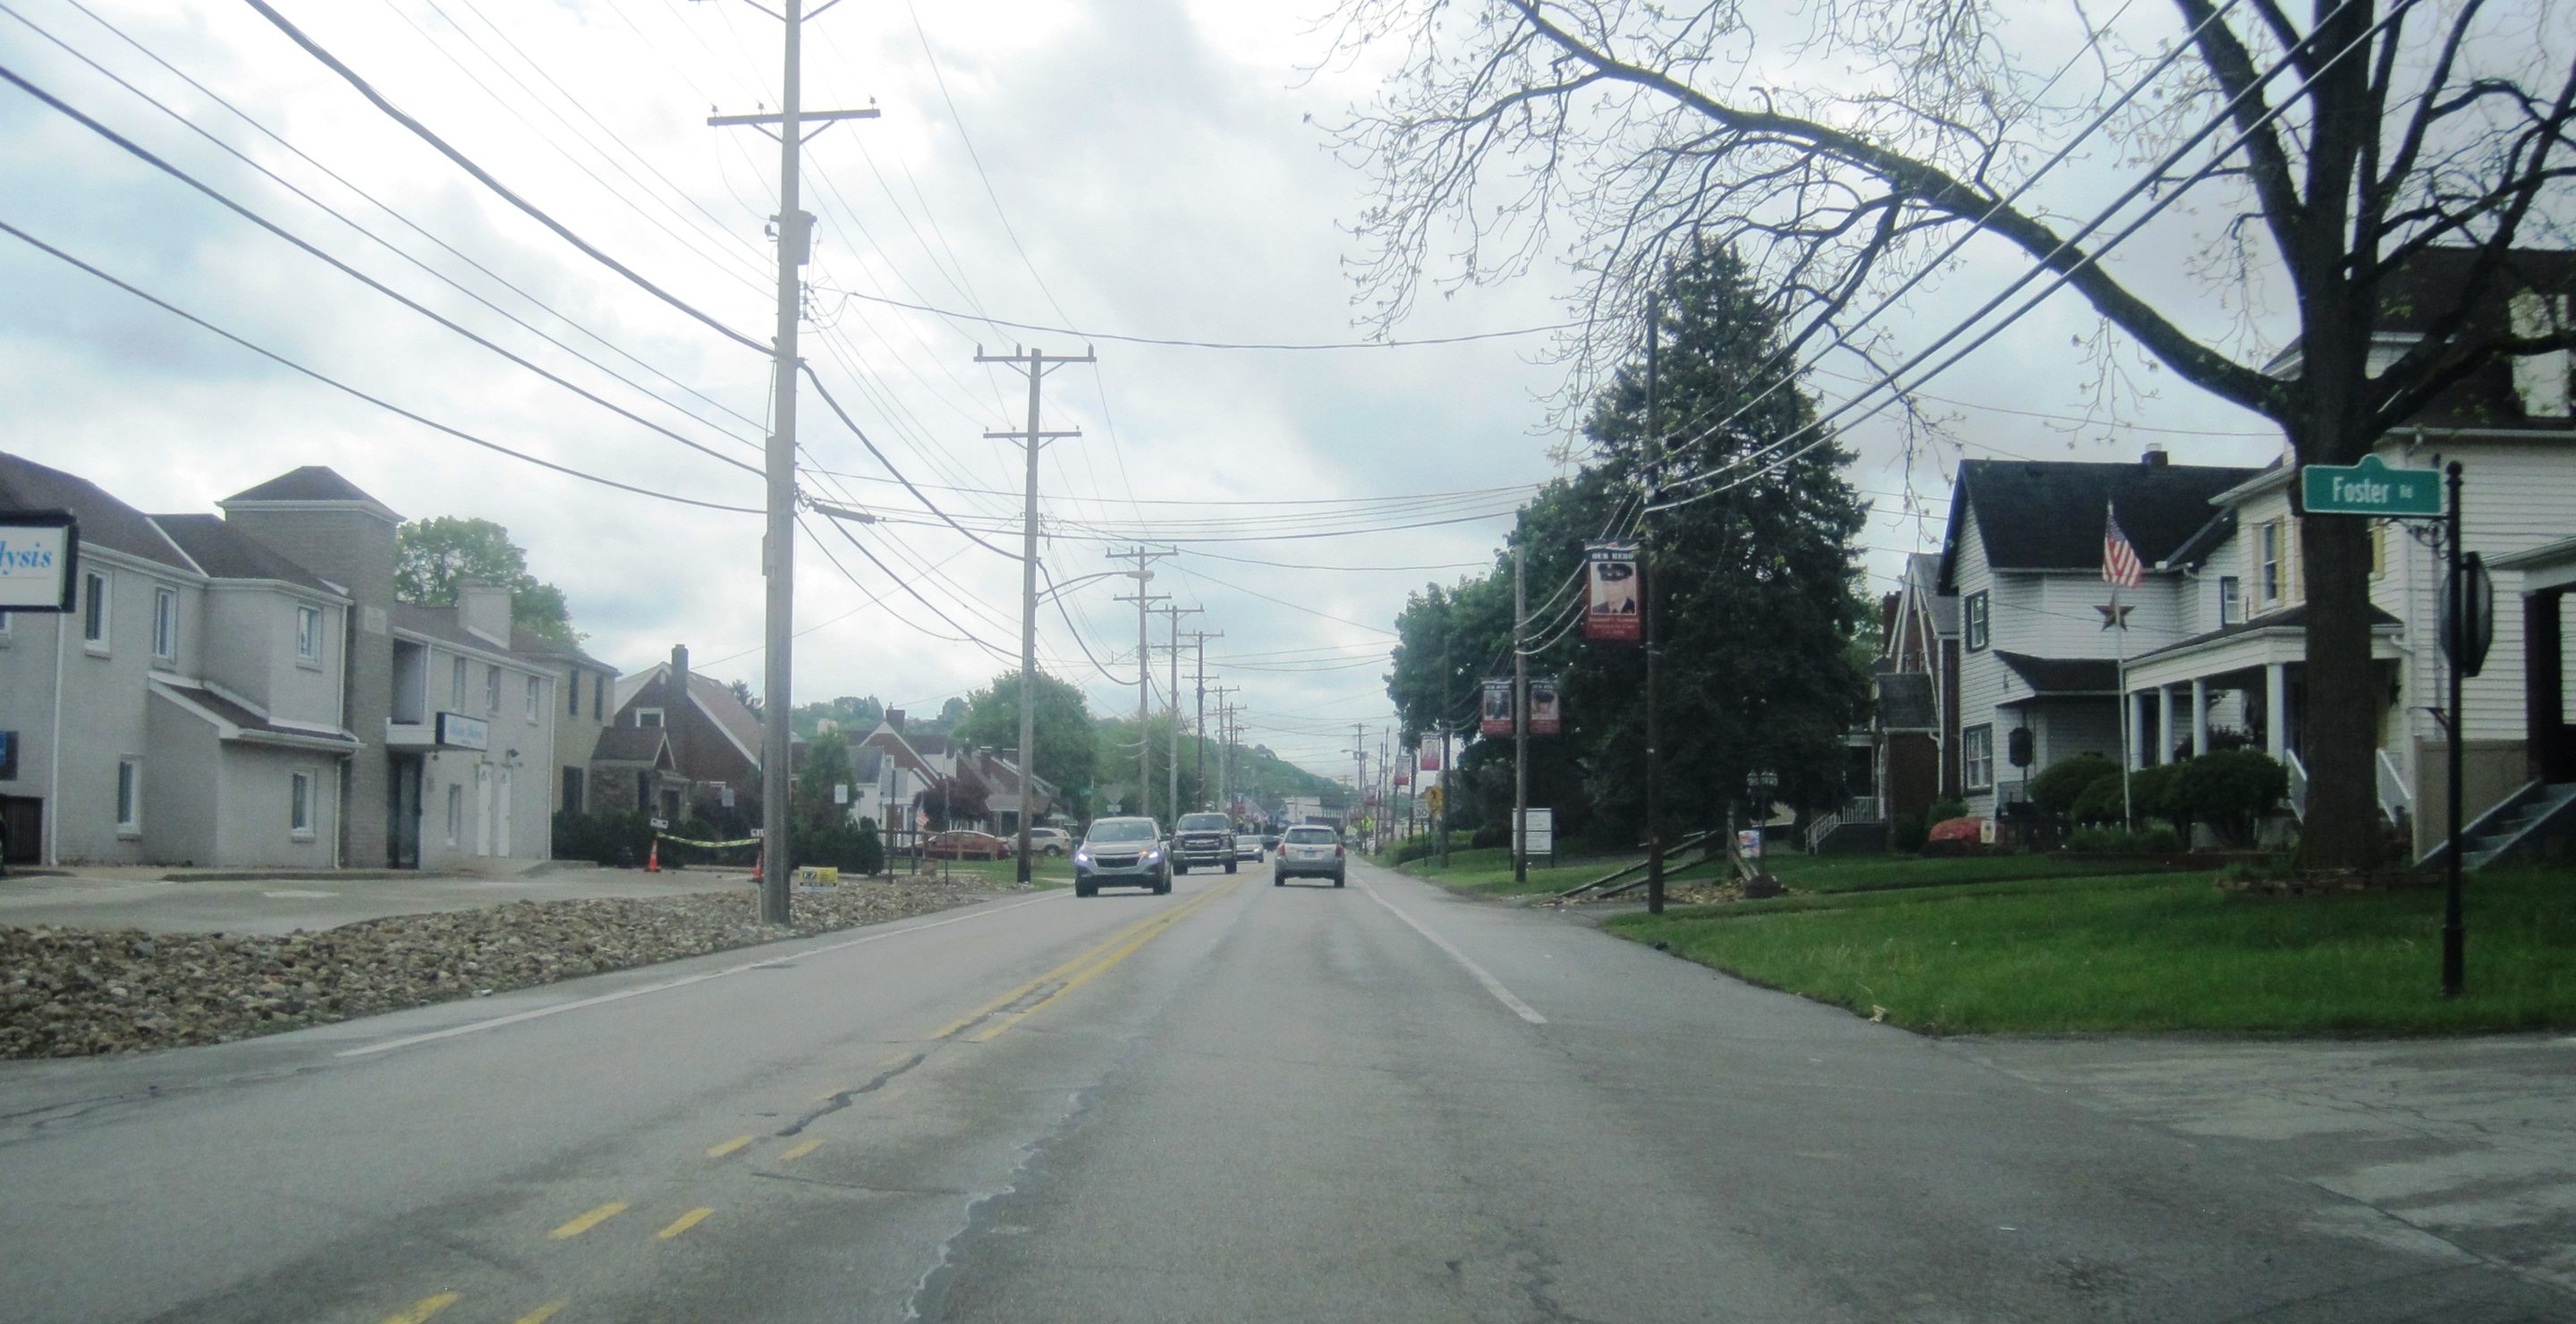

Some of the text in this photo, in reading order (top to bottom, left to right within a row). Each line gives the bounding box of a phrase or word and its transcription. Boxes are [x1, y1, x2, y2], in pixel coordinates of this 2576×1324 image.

[2332, 476, 2389, 503] Foster
[0, 540, 52, 575] lysis
[1415, 809, 1428, 817] 30
